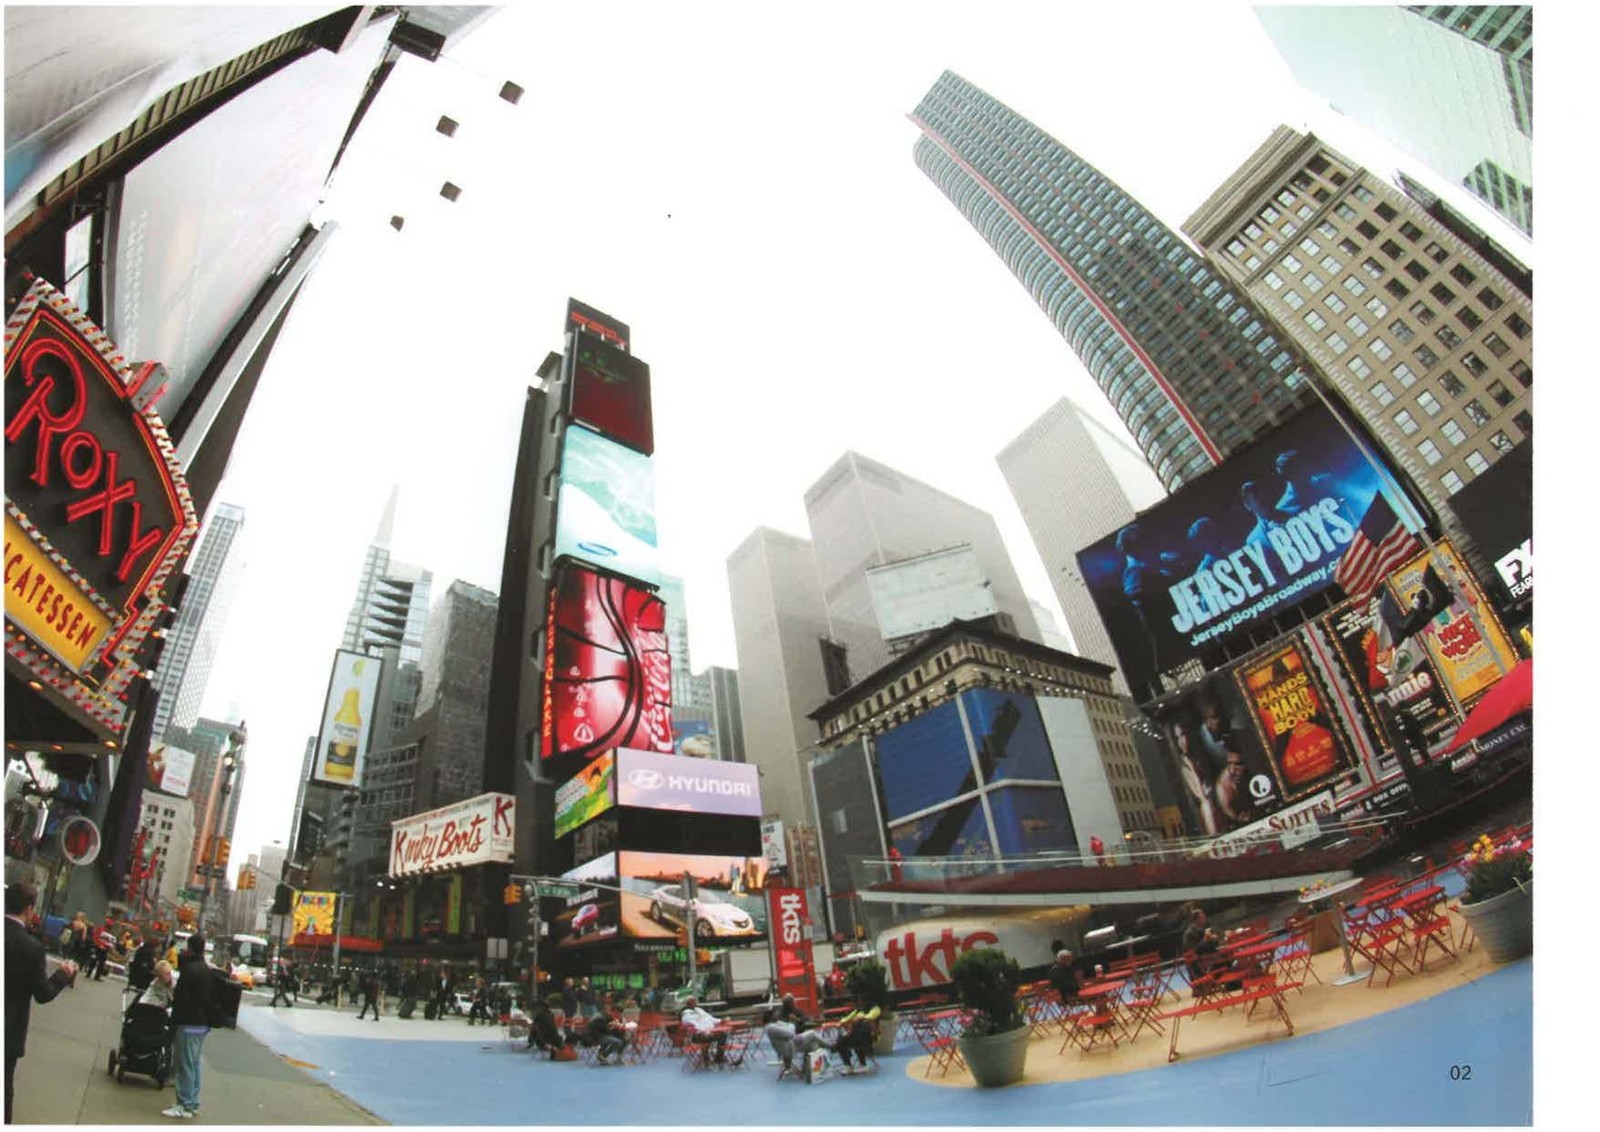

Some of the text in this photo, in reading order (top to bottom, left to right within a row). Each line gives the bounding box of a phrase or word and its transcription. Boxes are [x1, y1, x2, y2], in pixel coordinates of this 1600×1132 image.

[1168, 540, 1277, 634] JERSEY
[1266, 497, 1353, 576] BOYS
[668, 775, 752, 797] HYUNDAI
[393, 814, 487, 873] Kinky Boots
[779, 892, 803, 946] tkts
